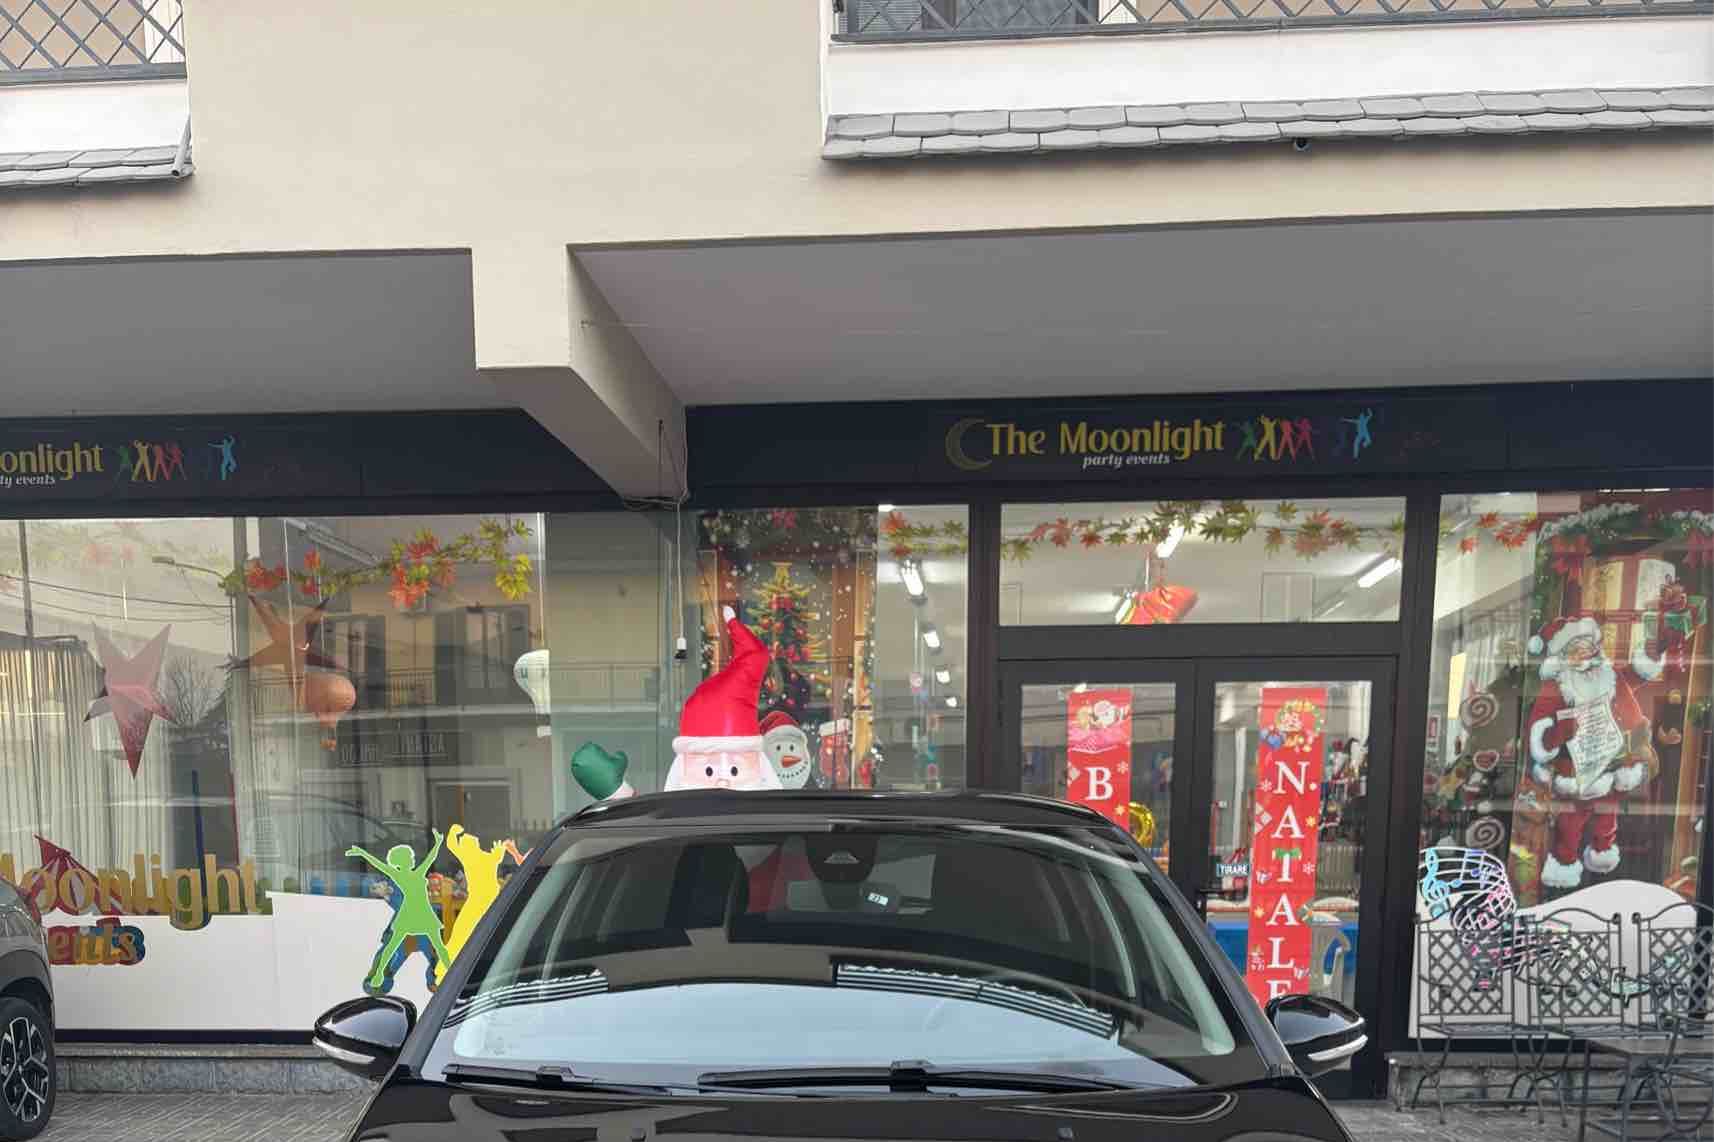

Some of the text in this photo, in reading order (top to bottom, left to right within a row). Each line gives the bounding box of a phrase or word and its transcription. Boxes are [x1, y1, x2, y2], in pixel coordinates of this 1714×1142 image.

[984, 419, 1226, 460] The Moonlight
[16, 473, 56, 485] events
[1082, 453, 1170, 469] party events
[1086, 766, 1113, 800] B
[0, 853, 258, 927] oonlight
[1266, 760, 1310, 1001] NATALE
